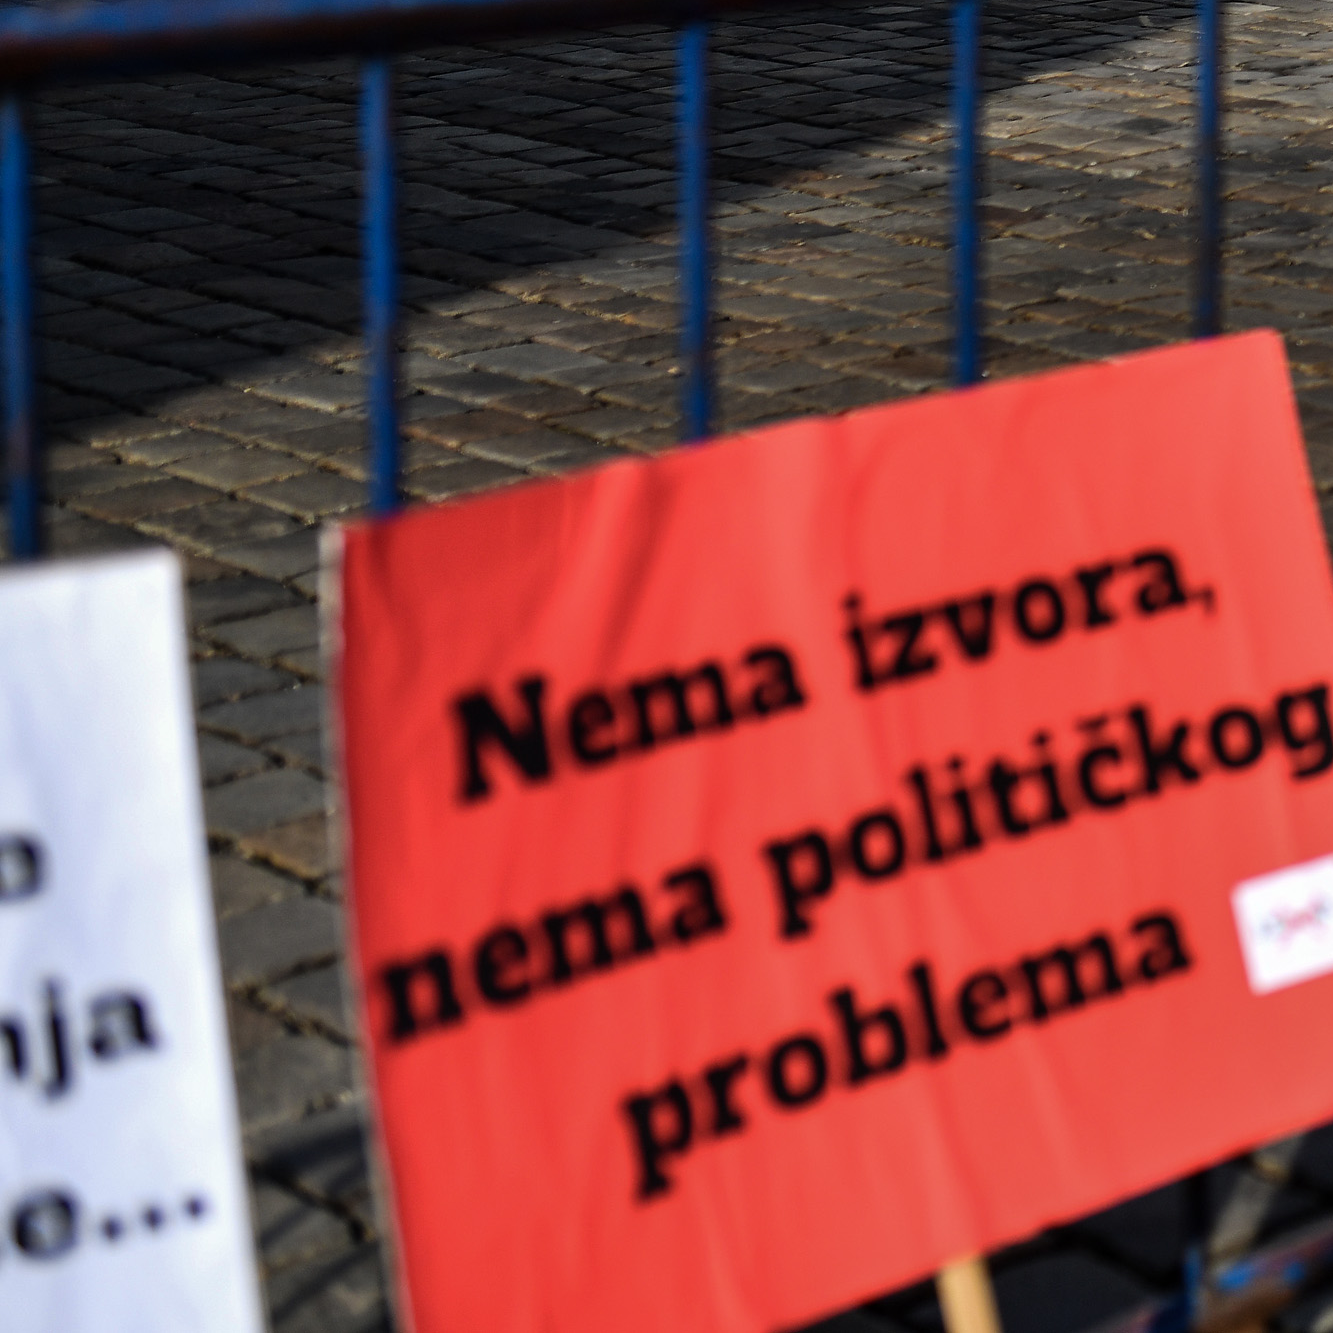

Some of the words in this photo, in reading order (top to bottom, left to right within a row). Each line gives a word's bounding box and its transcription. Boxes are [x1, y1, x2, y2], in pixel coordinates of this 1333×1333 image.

[450, 641, 810, 807] Nema
[843, 546, 1218, 695] izvora,
[366, 860, 730, 1050] nema
[620, 910, 1195, 1204] problema
